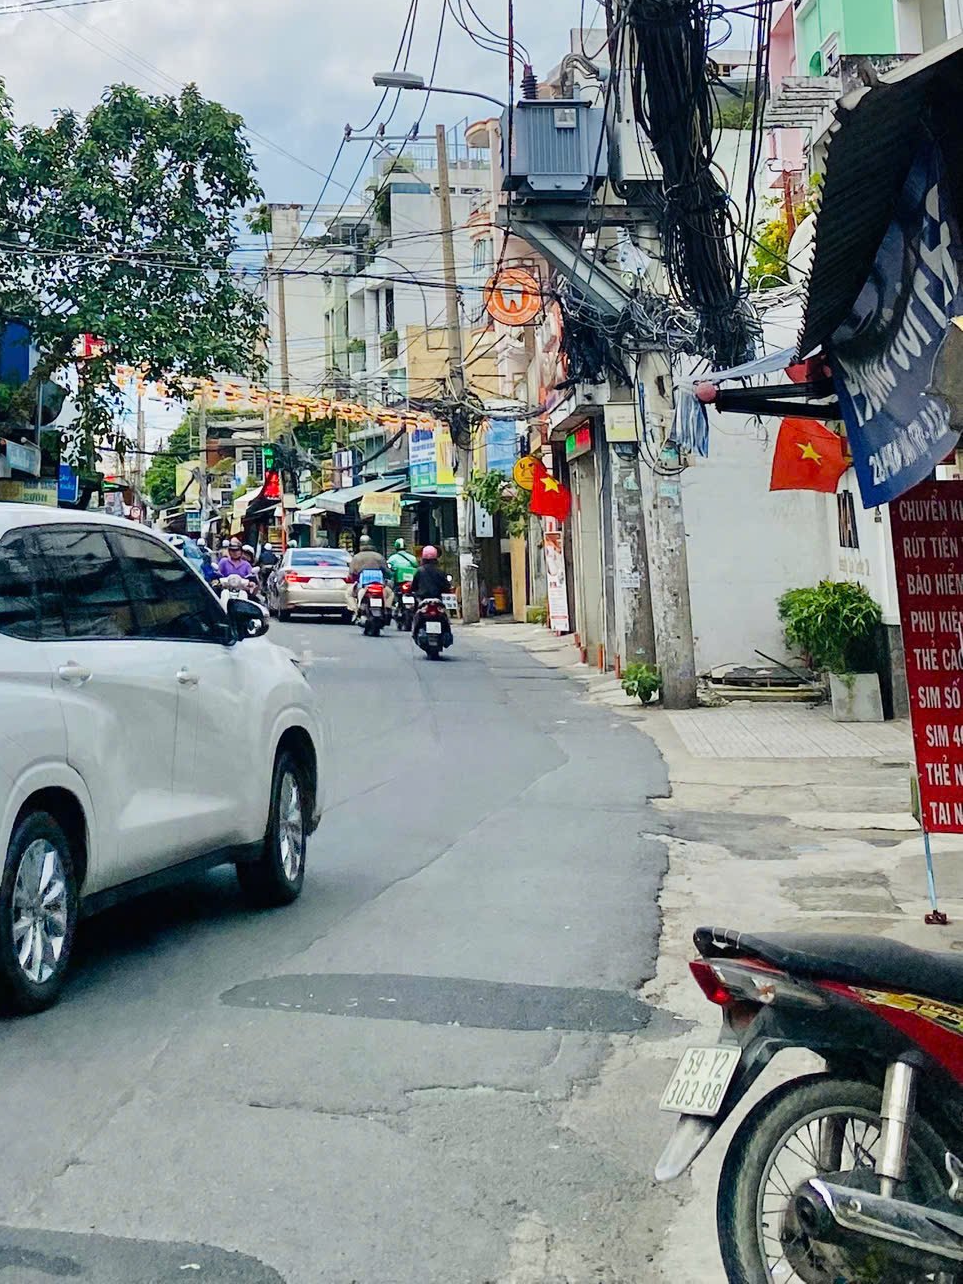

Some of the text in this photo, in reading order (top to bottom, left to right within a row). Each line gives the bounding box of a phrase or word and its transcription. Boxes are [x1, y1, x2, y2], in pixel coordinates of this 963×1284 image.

[898, 489, 948, 522] CHUYỂN
[903, 527, 959, 559] RÚT TIỀN
[906, 565, 932, 596] BẢO
[910, 610, 936, 638] PHỤ
[913, 639, 939, 671] THẺ
[917, 677, 962, 709] SIM SỐ
[925, 724, 950, 748] SIM
[925, 754, 951, 786] THẺ
[929, 801, 951, 826] TAI
[666, 1079, 722, 1109] 303.98
